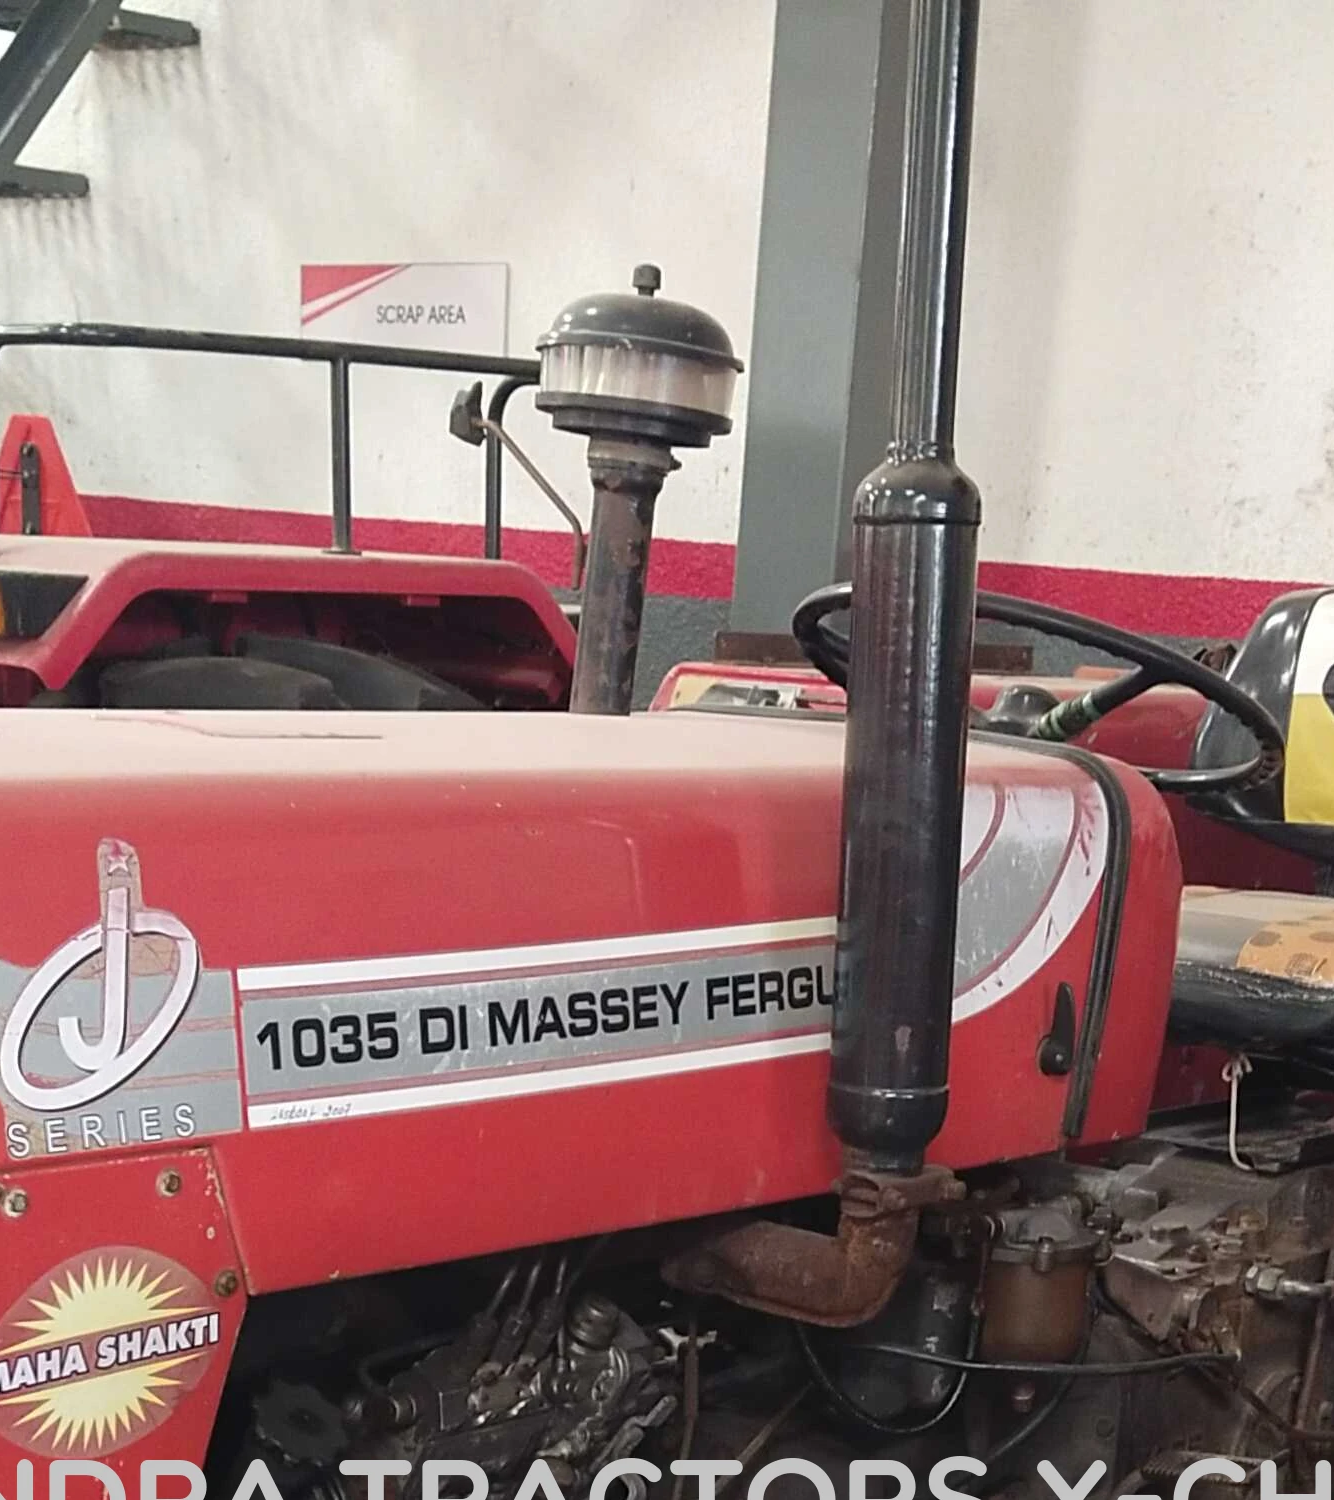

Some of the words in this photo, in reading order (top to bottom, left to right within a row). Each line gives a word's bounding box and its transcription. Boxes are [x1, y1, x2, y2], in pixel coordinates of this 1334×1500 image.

[376, 305, 423, 324] SCRAP
[427, 304, 466, 323] AREA
[257, 1011, 399, 1070] 1035
[419, 1004, 469, 1055] DI
[488, 979, 691, 1048] MASSEY
[705, 966, 836, 1021] FERGU
[7, 1103, 197, 1160] SERIES
[95, 1313, 221, 1370] SHAKTI
